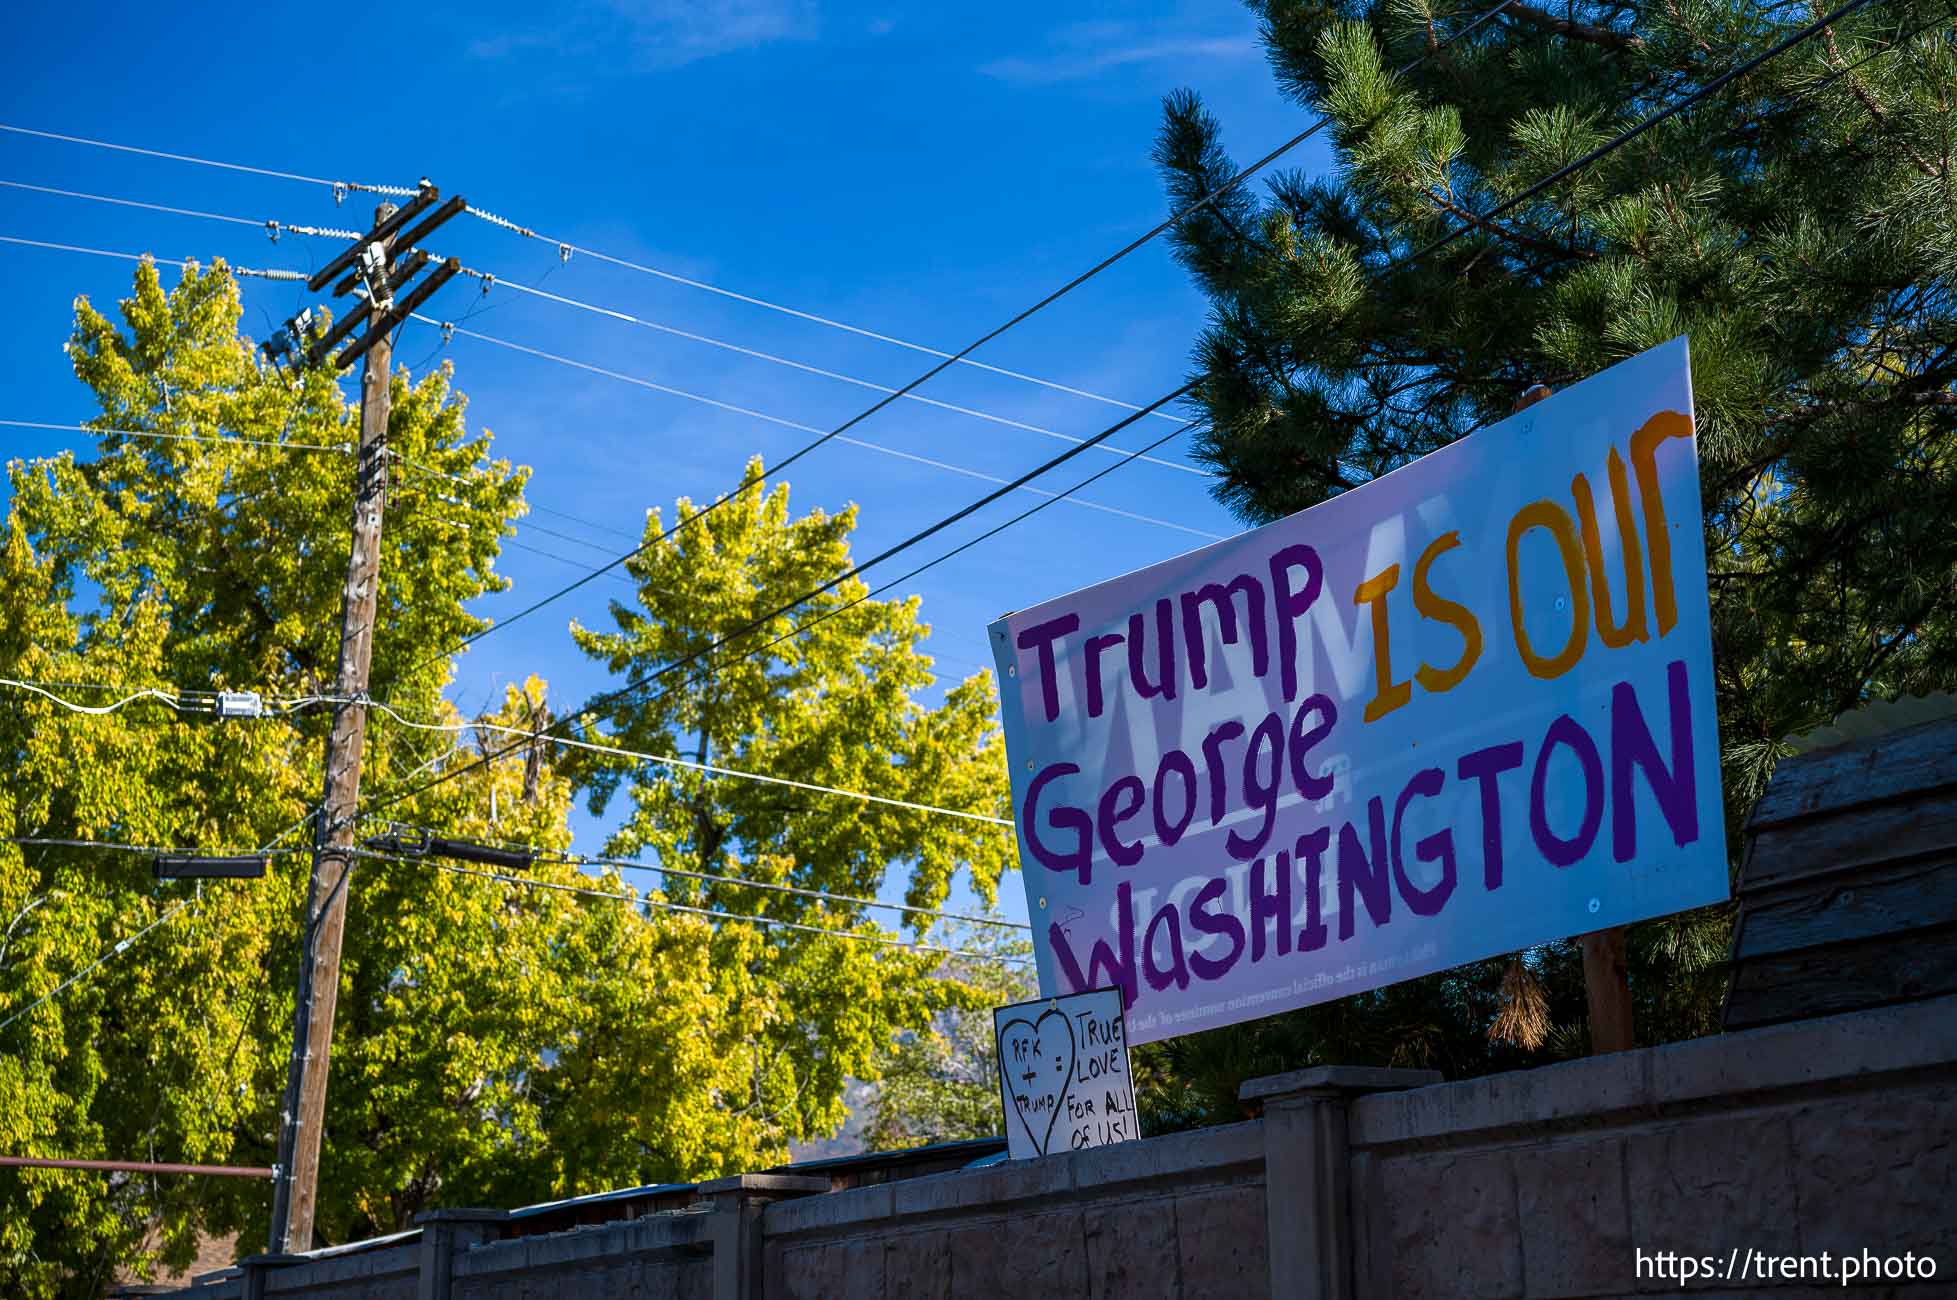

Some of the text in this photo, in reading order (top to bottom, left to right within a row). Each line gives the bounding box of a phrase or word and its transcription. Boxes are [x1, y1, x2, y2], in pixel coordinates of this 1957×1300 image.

[1016, 543, 1324, 723] Trump
[1353, 530, 1483, 723] IS
[1022, 692, 1338, 886] George
[1075, 1010, 1122, 1049] TRUE
[1011, 1037, 1042, 1063] RFK
[1076, 1048, 1121, 1083] LOVE
[1016, 1093, 1055, 1114] TRUMP
[1066, 1089, 1135, 1122] FOR ALL
